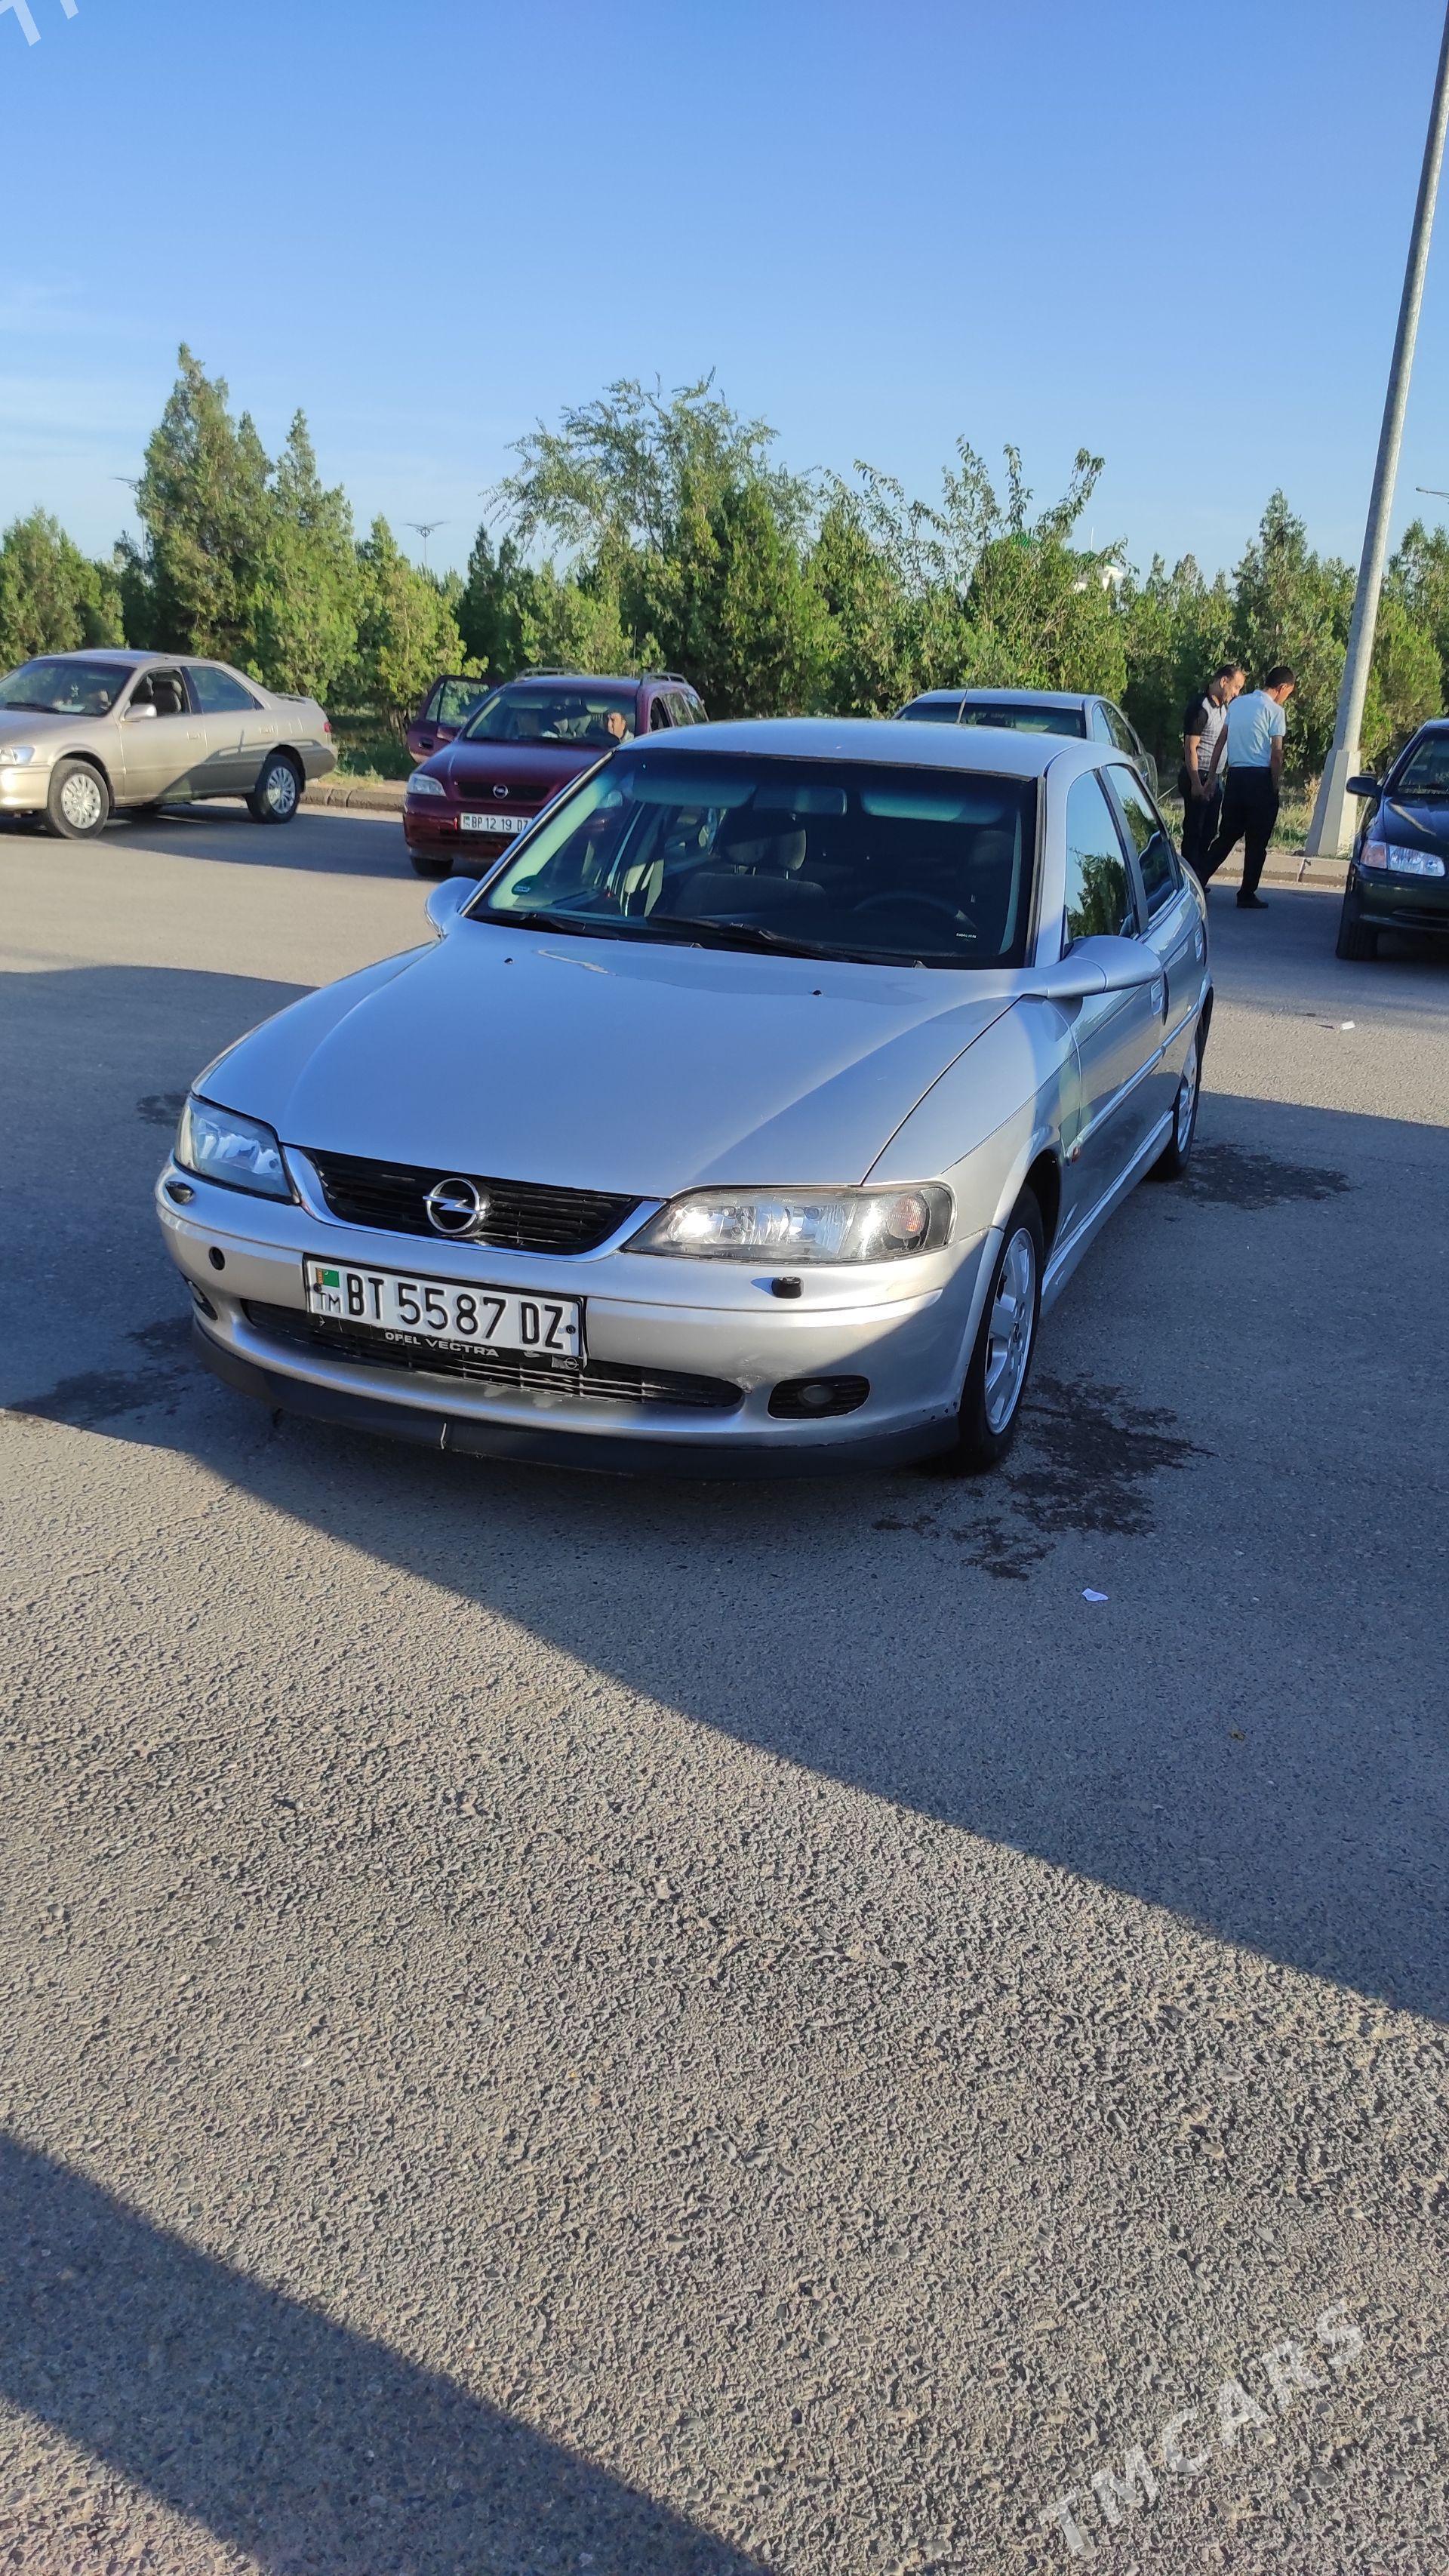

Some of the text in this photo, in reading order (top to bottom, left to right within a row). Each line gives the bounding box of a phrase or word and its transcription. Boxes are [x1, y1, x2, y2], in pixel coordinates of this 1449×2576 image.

[472, 816, 482, 829] BP
[486, 817, 497, 830] 12
[501, 818, 512, 831] 19
[318, 1291, 341, 1313] TM
[346, 1273, 564, 1350] BT 5587 DZ
[385, 1331, 500, 1358] OPEL VECTRA
